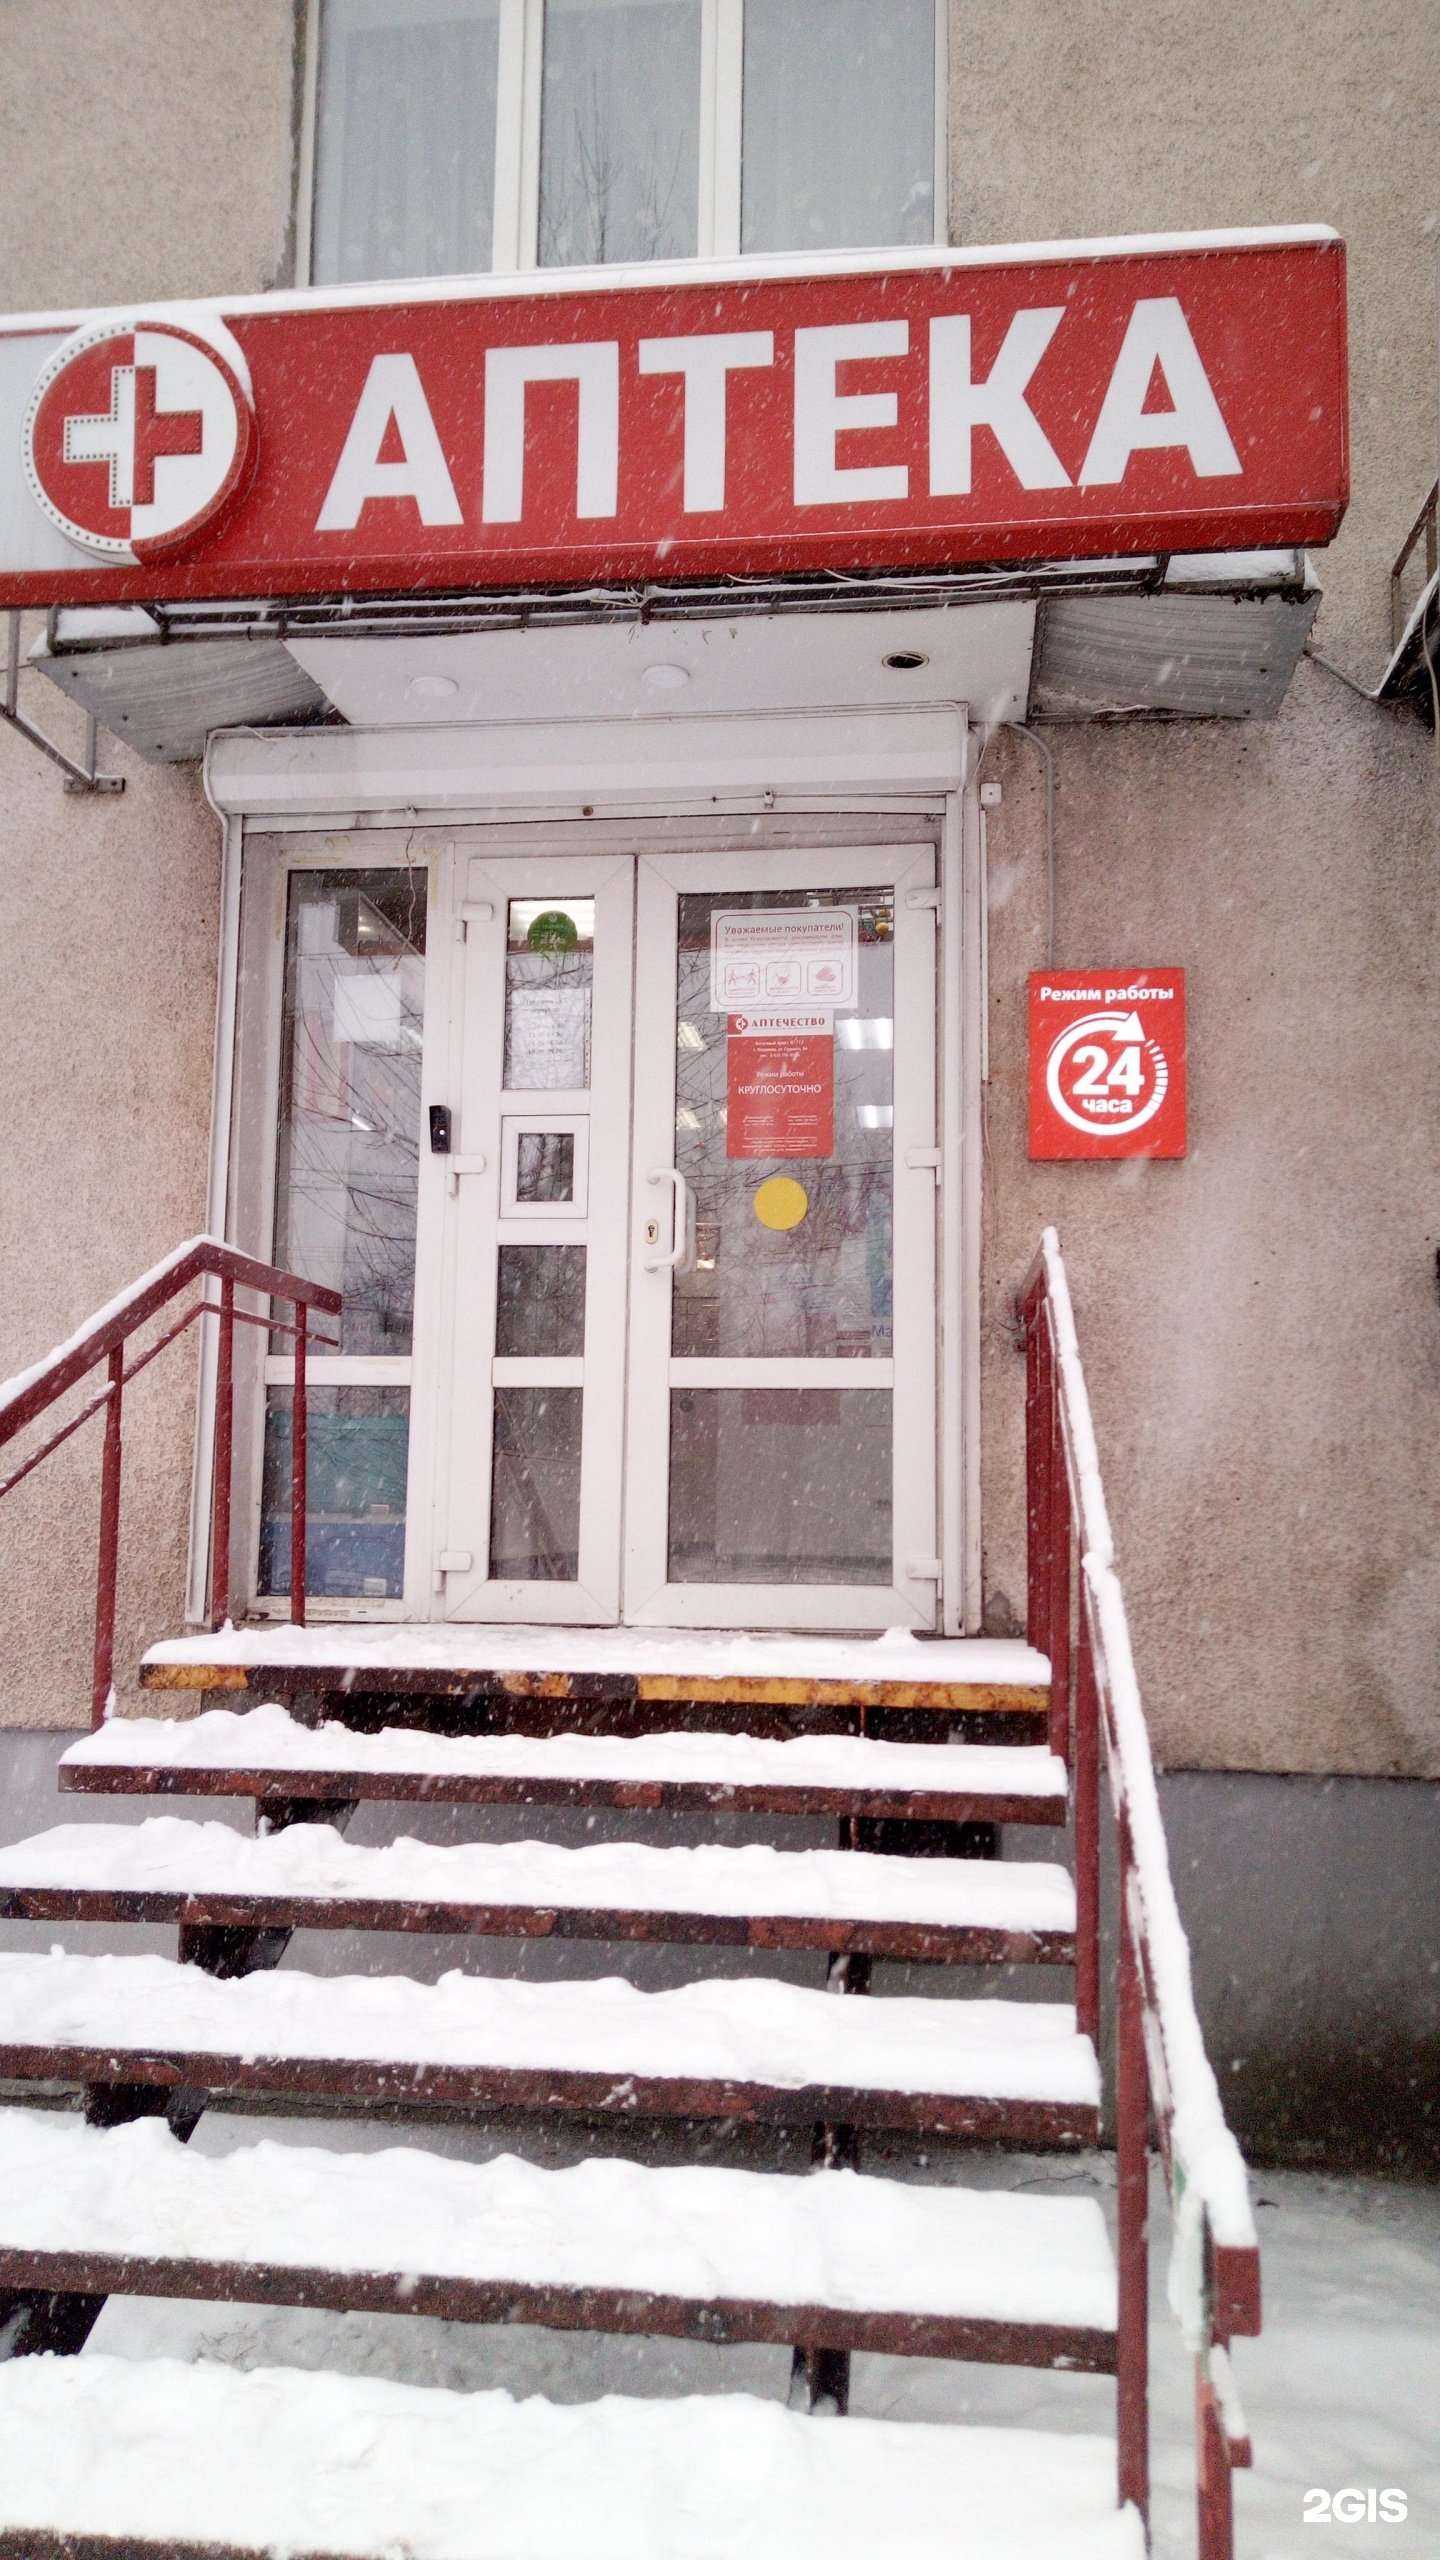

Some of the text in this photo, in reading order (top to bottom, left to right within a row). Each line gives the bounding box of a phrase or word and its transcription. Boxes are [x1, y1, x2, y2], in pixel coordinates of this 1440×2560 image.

[315, 297, 1243, 532] АПТЕКА
[724, 922, 844, 936] Уважаемые покупатели!
[1040, 985, 1174, 1004] Режим работы
[751, 1017, 826, 1028] АПТЕЧЕСТВО
[1071, 1045, 1146, 1096] 24
[738, 1083, 822, 1095] КРУГЛОСУТОЧНО
[1081, 1099, 1133, 1114] часа
